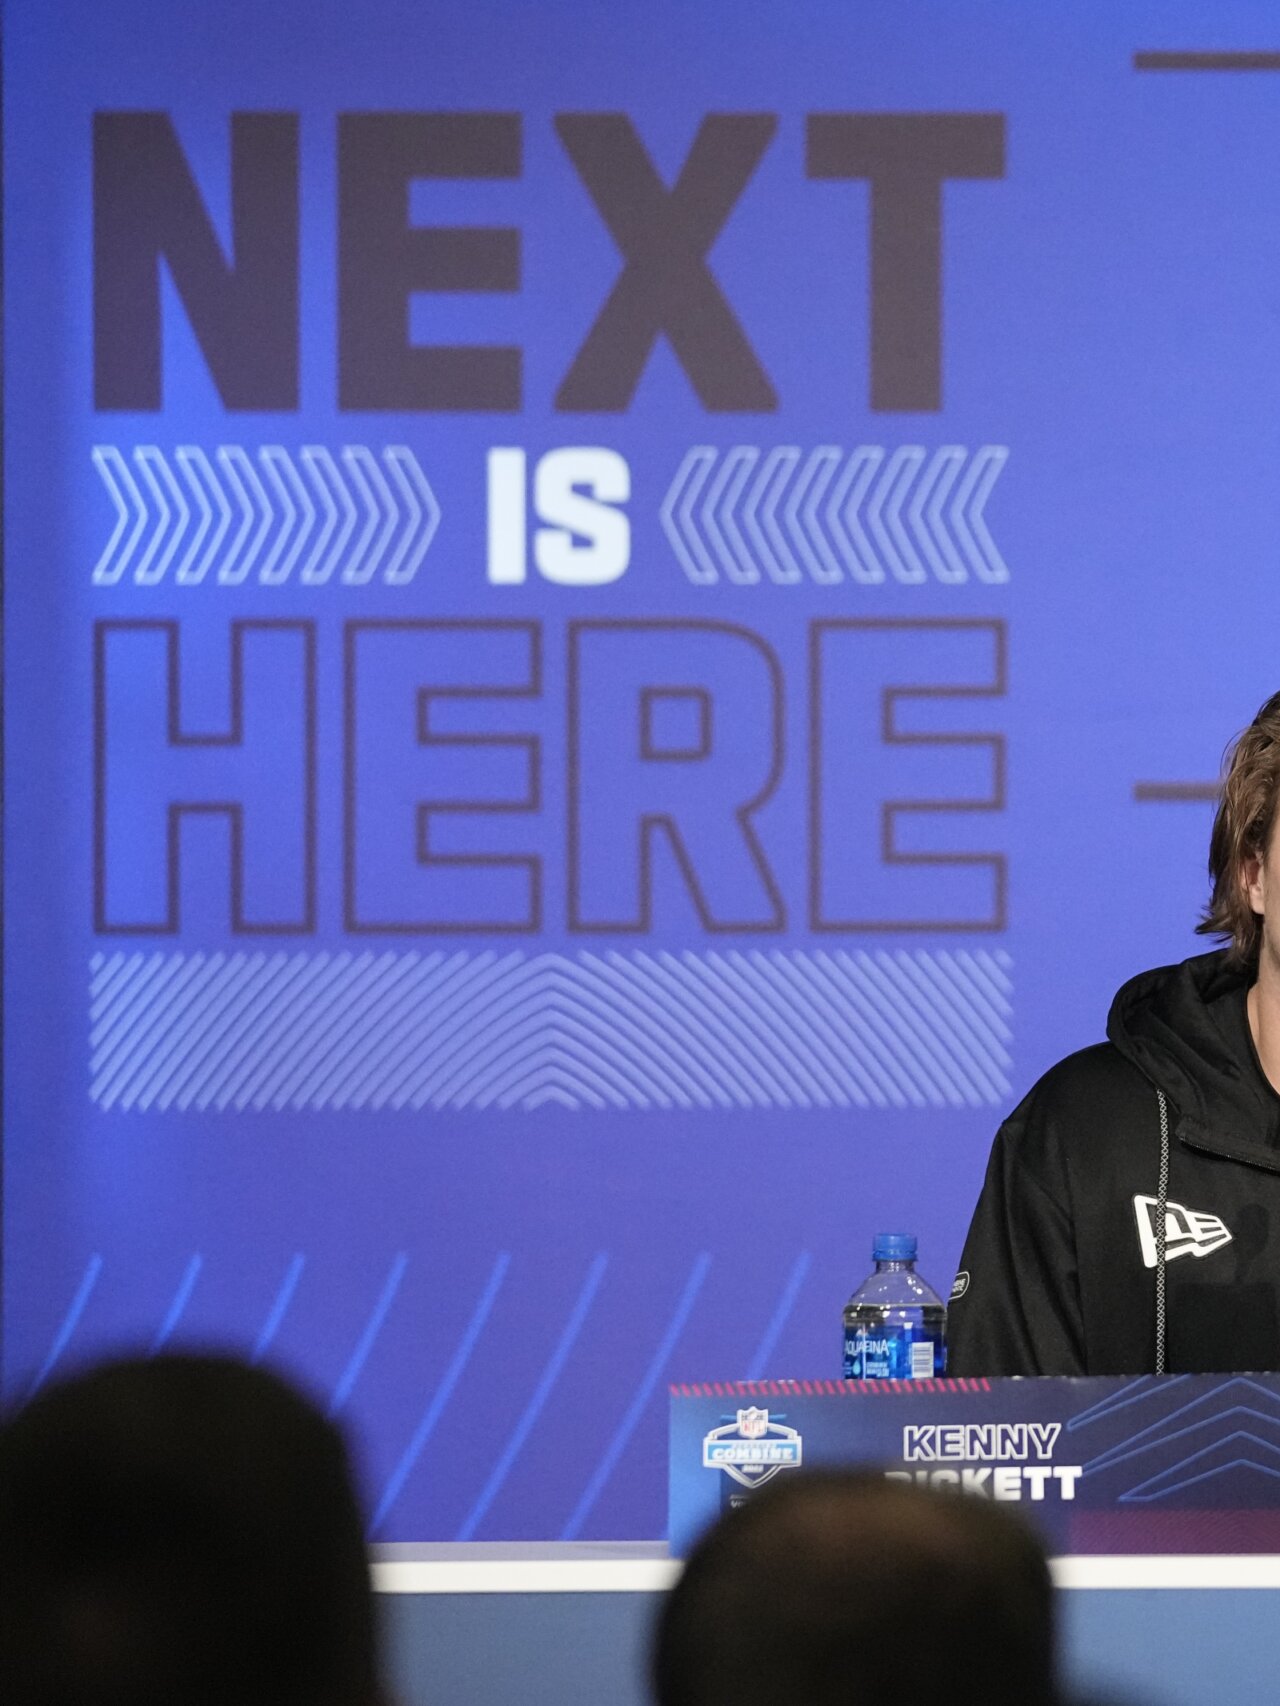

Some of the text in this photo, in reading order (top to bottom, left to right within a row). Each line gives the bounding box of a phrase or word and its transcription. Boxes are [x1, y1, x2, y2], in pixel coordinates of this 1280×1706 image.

[91, 110, 1007, 414] NEXT
[487, 445, 631, 586] IS
[93, 617, 1008, 936] HERE
[712, 1447, 794, 1461] COMBINE
[903, 1423, 1062, 1462] KENNY
